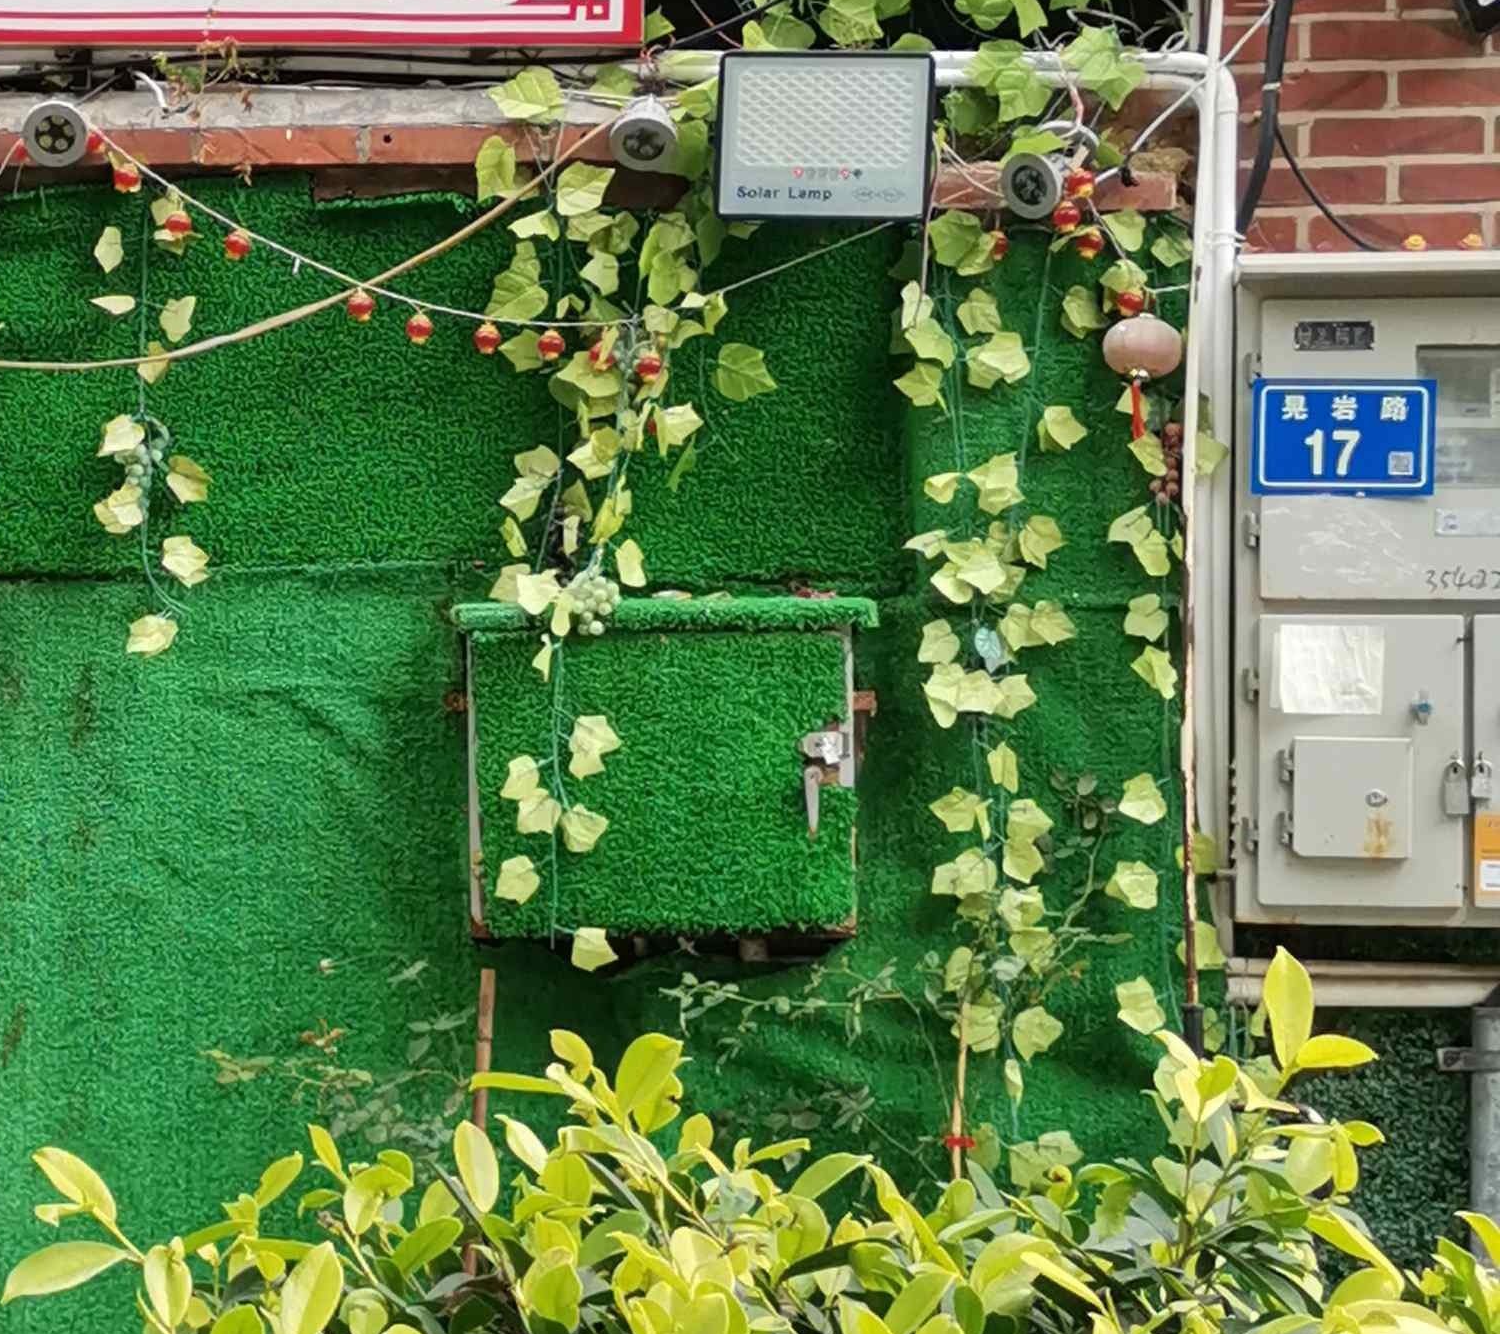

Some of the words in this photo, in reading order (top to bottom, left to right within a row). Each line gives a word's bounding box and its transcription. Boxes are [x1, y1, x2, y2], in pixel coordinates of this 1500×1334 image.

[737, 185, 780, 200] Solar
[788, 186, 833, 201] Lamp
[1282, 394, 1409, 421] 晃岩路
[1304, 428, 1361, 476] 17
